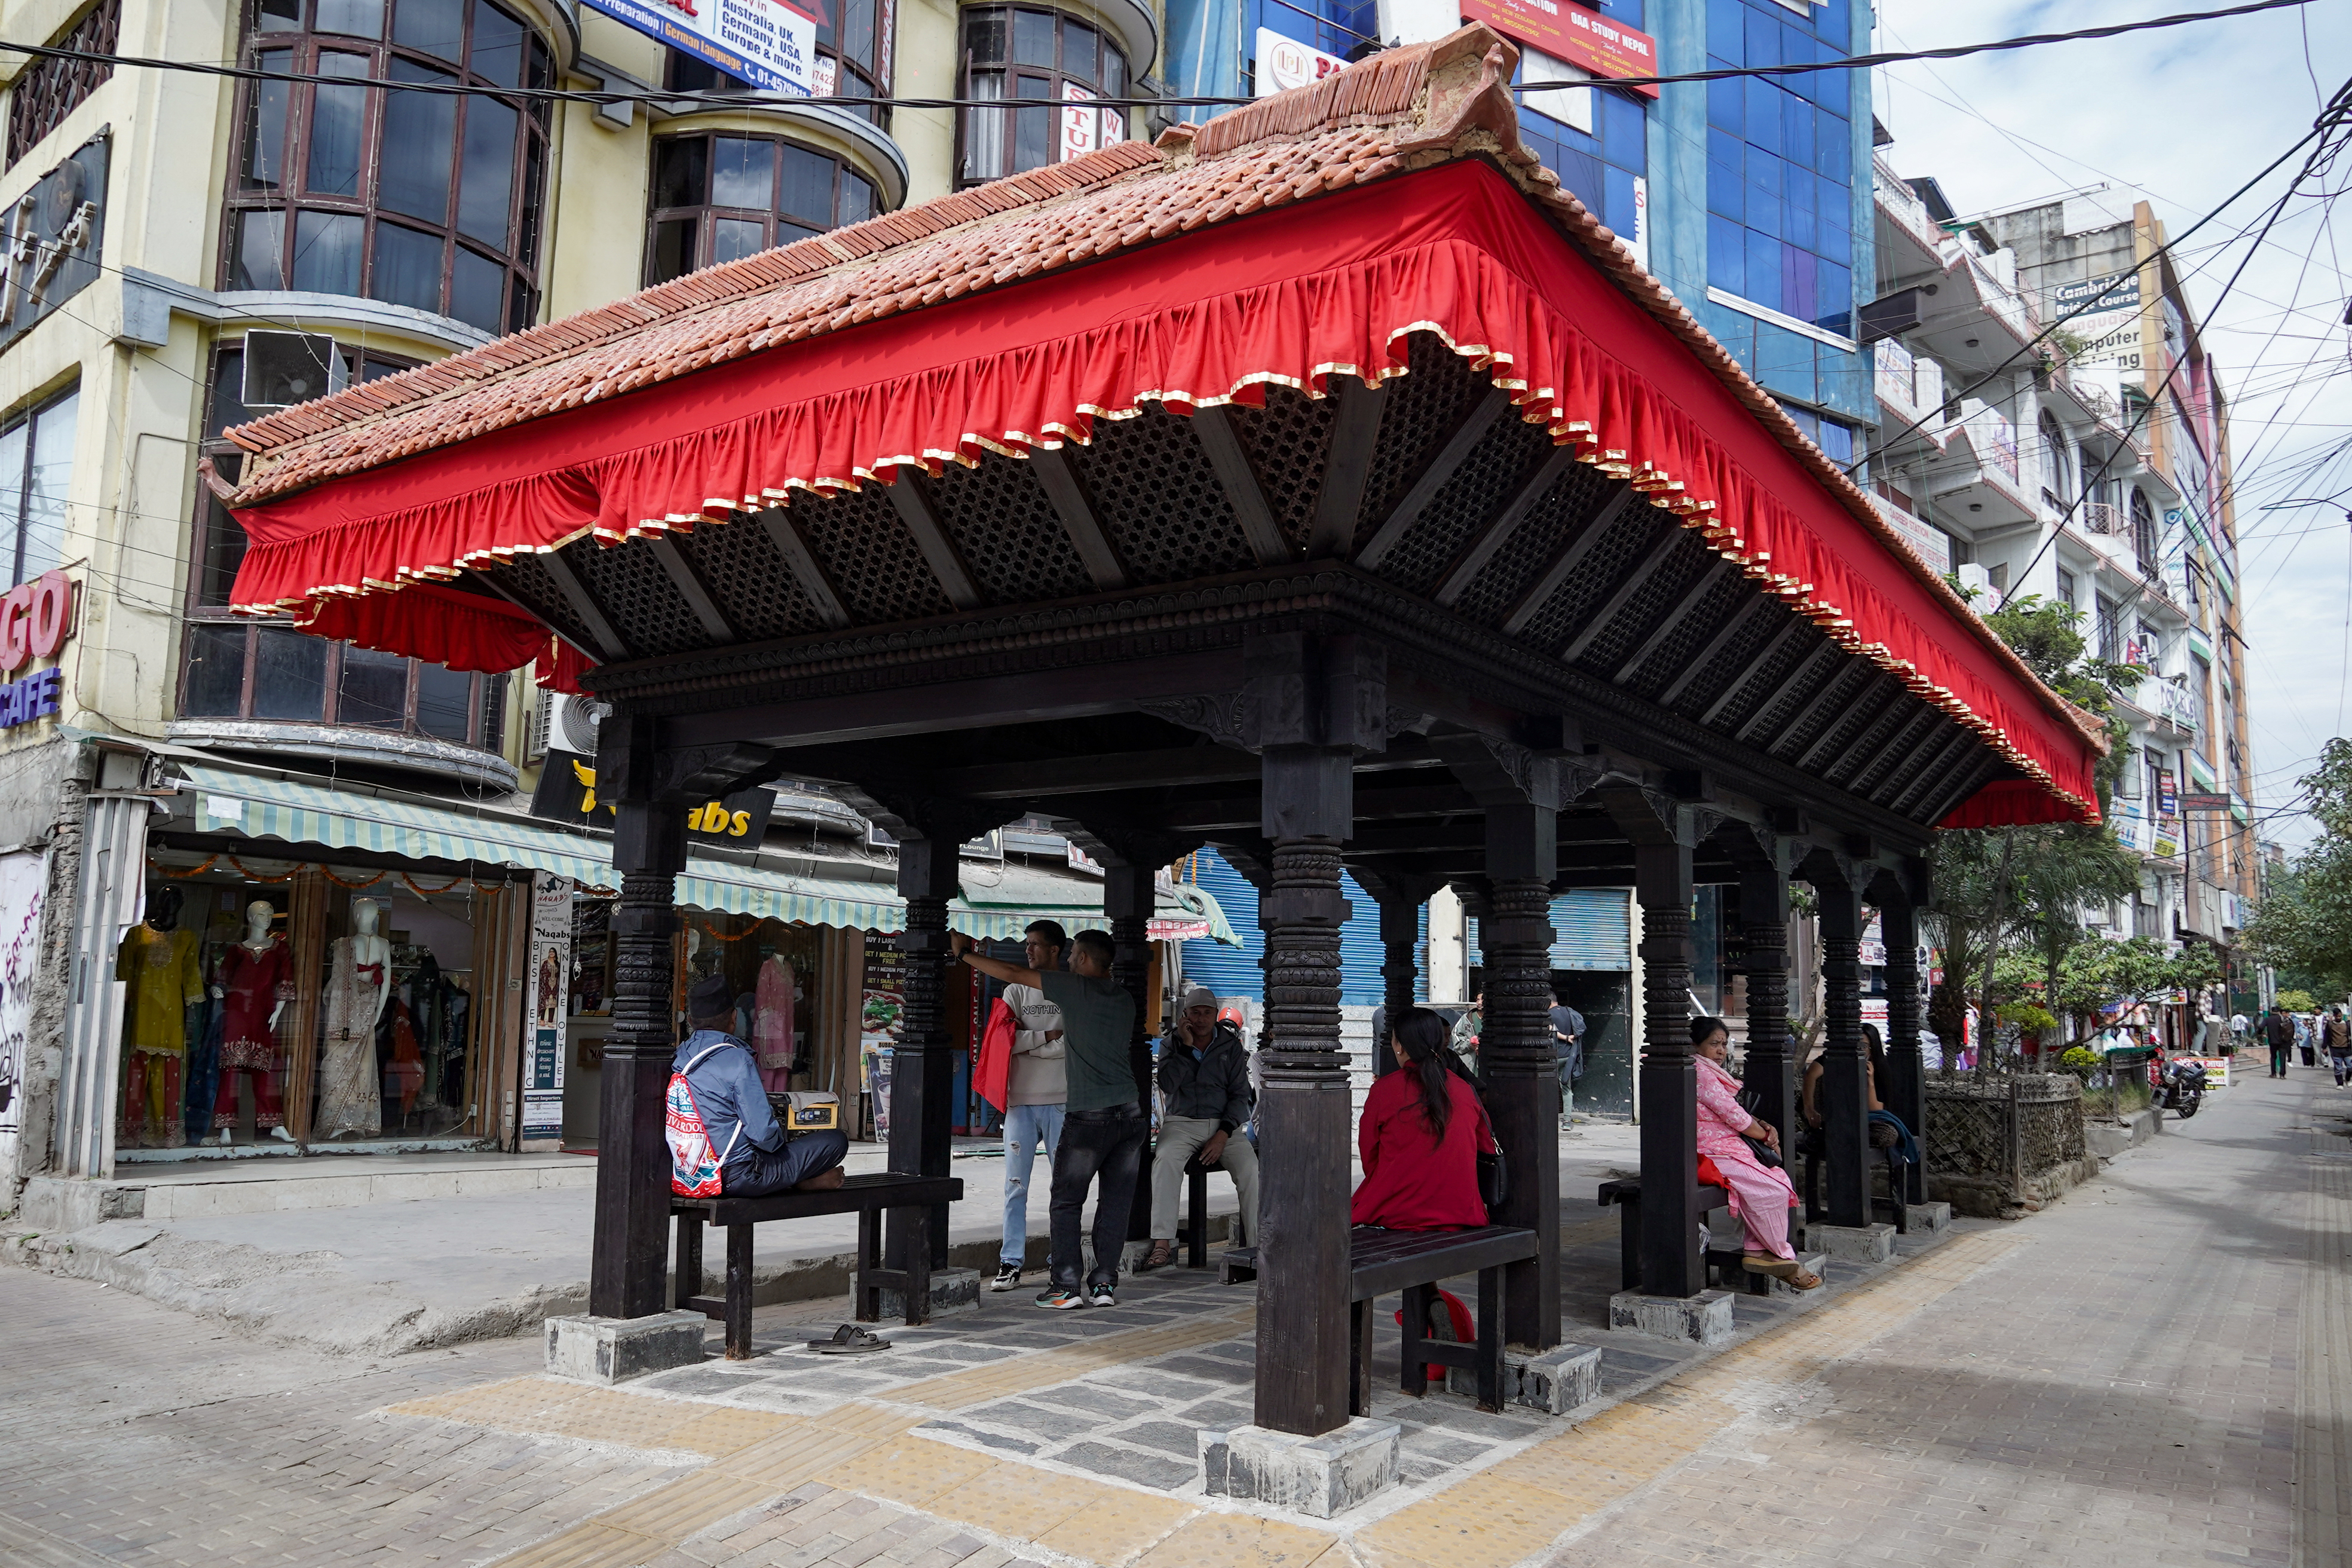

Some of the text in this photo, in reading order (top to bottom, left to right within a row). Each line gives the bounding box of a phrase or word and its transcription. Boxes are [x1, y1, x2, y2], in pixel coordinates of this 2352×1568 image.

[722, 0, 776, 35] Australia,
[779, 26, 795, 45] UK,
[1570, 12, 1650, 56] OAA STUDY NEPAL
[604, 0, 659, 30] Preparation
[665, 22, 700, 50] German
[700, 39, 742, 71] Language
[722, 11, 803, 63] Germany, USA,
[721, 25, 760, 54] Europe
[764, 49, 771, 60] &
[774, 54, 802, 75] more
[2056, 275, 2139, 300] Cambridge
[2098, 292, 2140, 307] Course
[963, 844, 990, 852] Lounge
[1071, 861, 1105, 876] BEAUTY COLLE
[537, 892, 568, 903] NAQABS
[534, 927, 571, 939] Naqabs
[1187, 930, 1206, 938] PRICE
[526, 941, 540, 1087] BEST ETHNIC
[556, 942, 569, 1086] ONLINE OUTLET
[1021, 1004, 1061, 1016] NOTHIN
